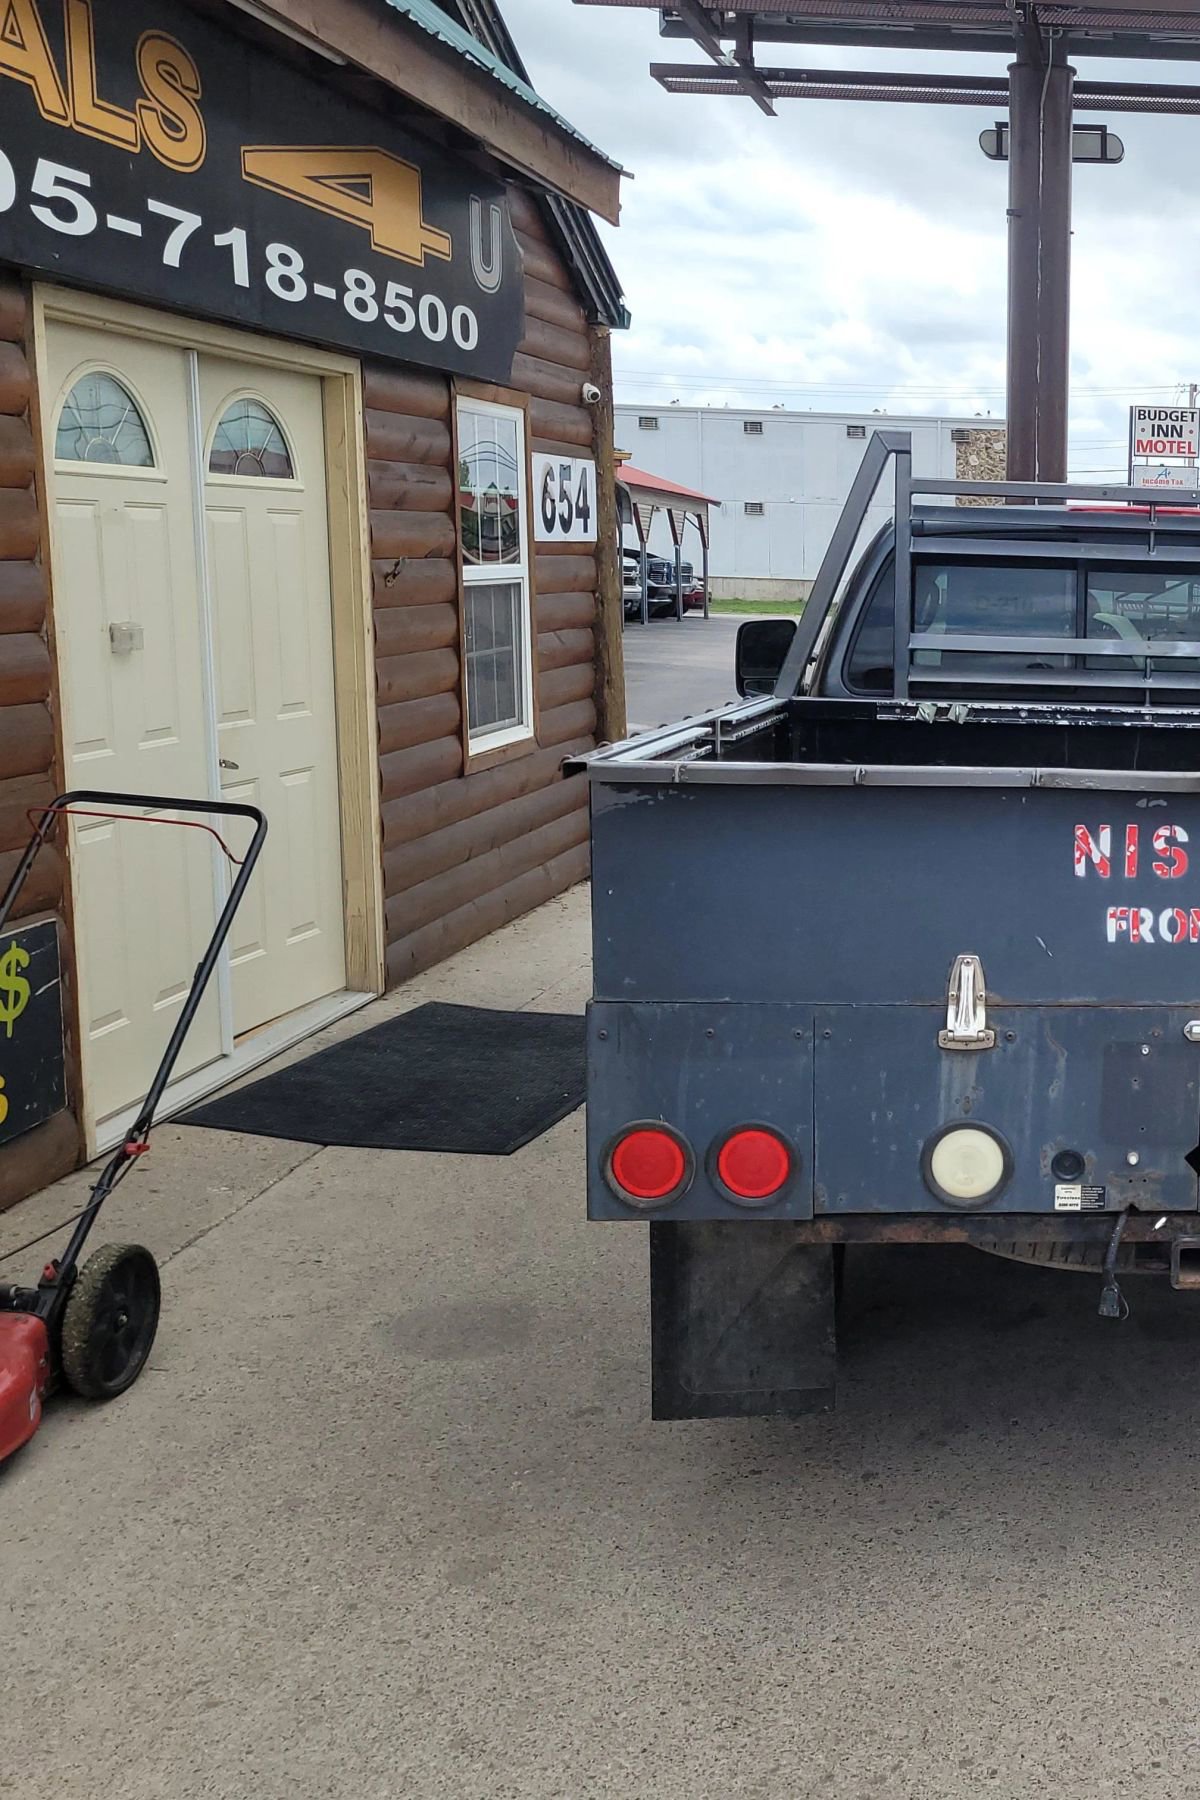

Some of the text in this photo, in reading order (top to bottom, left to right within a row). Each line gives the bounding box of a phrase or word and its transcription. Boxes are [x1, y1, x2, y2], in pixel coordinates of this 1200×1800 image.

[240, 145, 452, 268] 4
[468, 193, 502, 294] U
[0, 149, 479, 351] 5-718-8500
[1137, 409, 1197, 423] BUDGET
[1151, 424, 1183, 438] INN
[1136, 440, 1196, 455] MOTEL
[541, 462, 591, 534] 654
